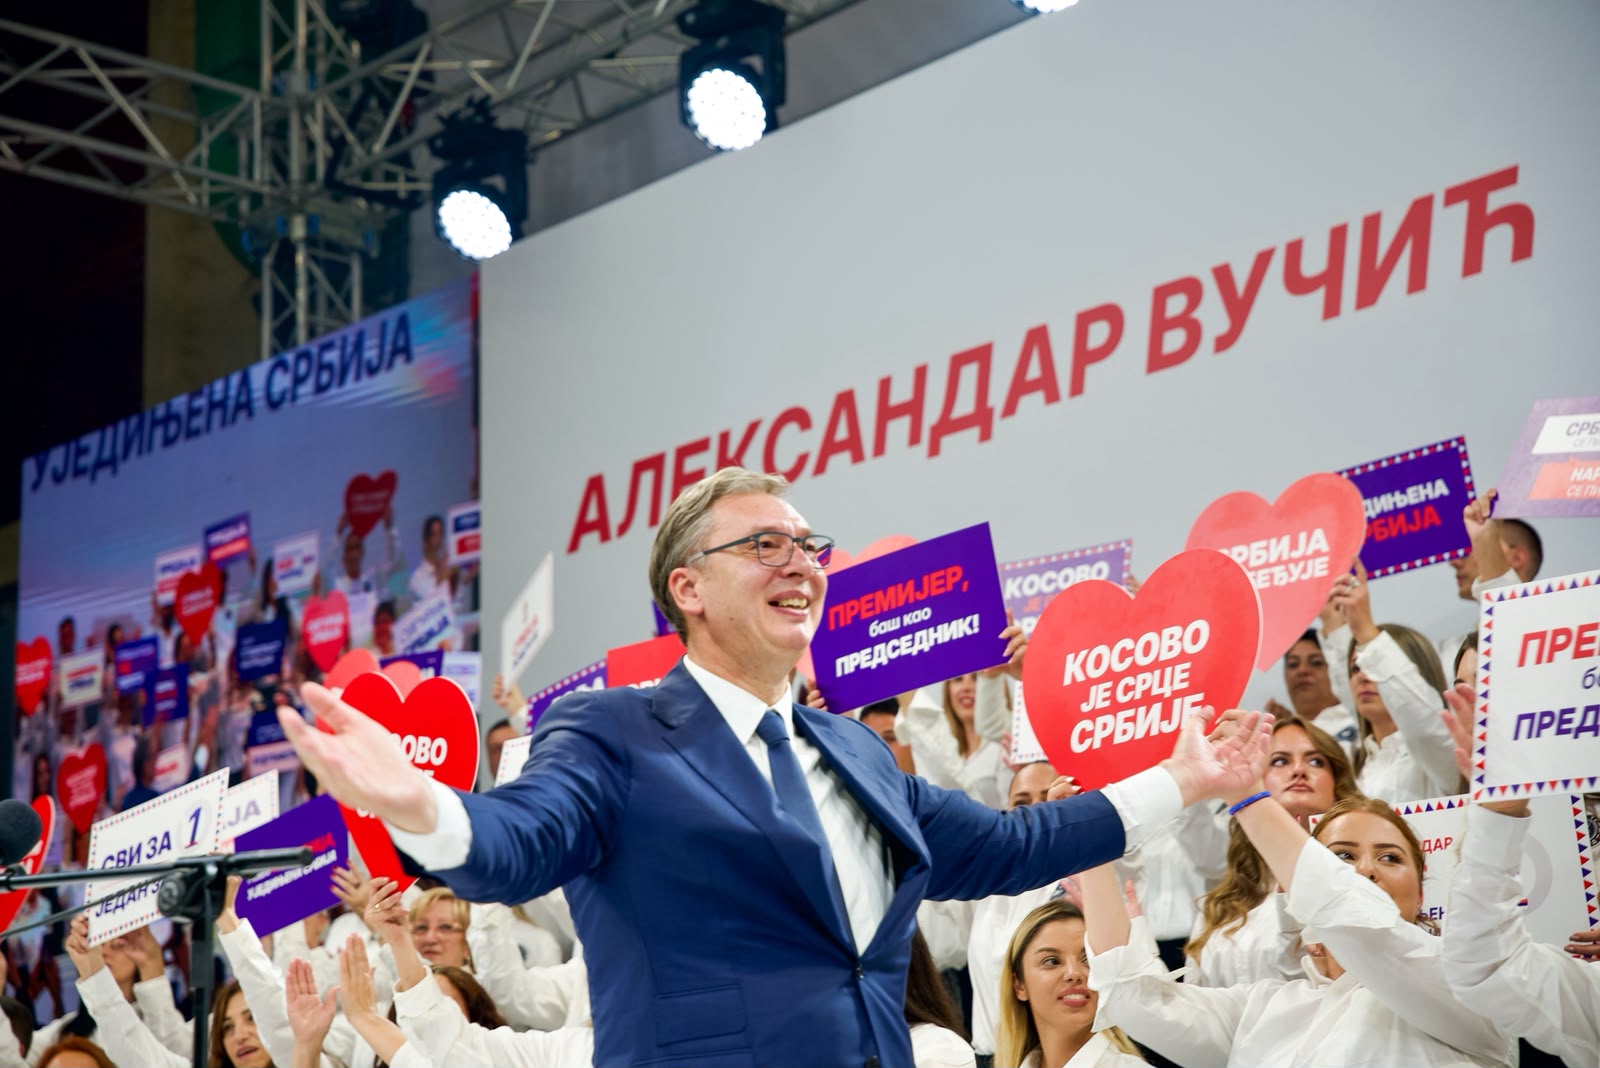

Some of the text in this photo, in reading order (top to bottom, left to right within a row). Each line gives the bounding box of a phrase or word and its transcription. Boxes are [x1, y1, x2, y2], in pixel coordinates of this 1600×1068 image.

[566, 163, 1536, 555] АЛЕКСАНДАР ВУЧИЋ
[31, 311, 414, 493] УЈЕДИЊЕНА СРБИЈА
[1218, 527, 1330, 568] РБИЈА
[828, 564, 970, 632] ПРЕМИЈЕР,
[1004, 560, 1111, 600] КОСОВО
[835, 613, 981, 678] ПРЕДСЕДНИК!
[868, 606, 932, 638] баш као
[1516, 621, 1600, 668] ПРЕ
[1062, 618, 1211, 687] КОСОВО
[1080, 661, 1193, 713] ЈЕ СРЦЕ
[101, 805, 203, 873] СВИ ЗА 1
[95, 880, 149, 918] ЈЕДАН
